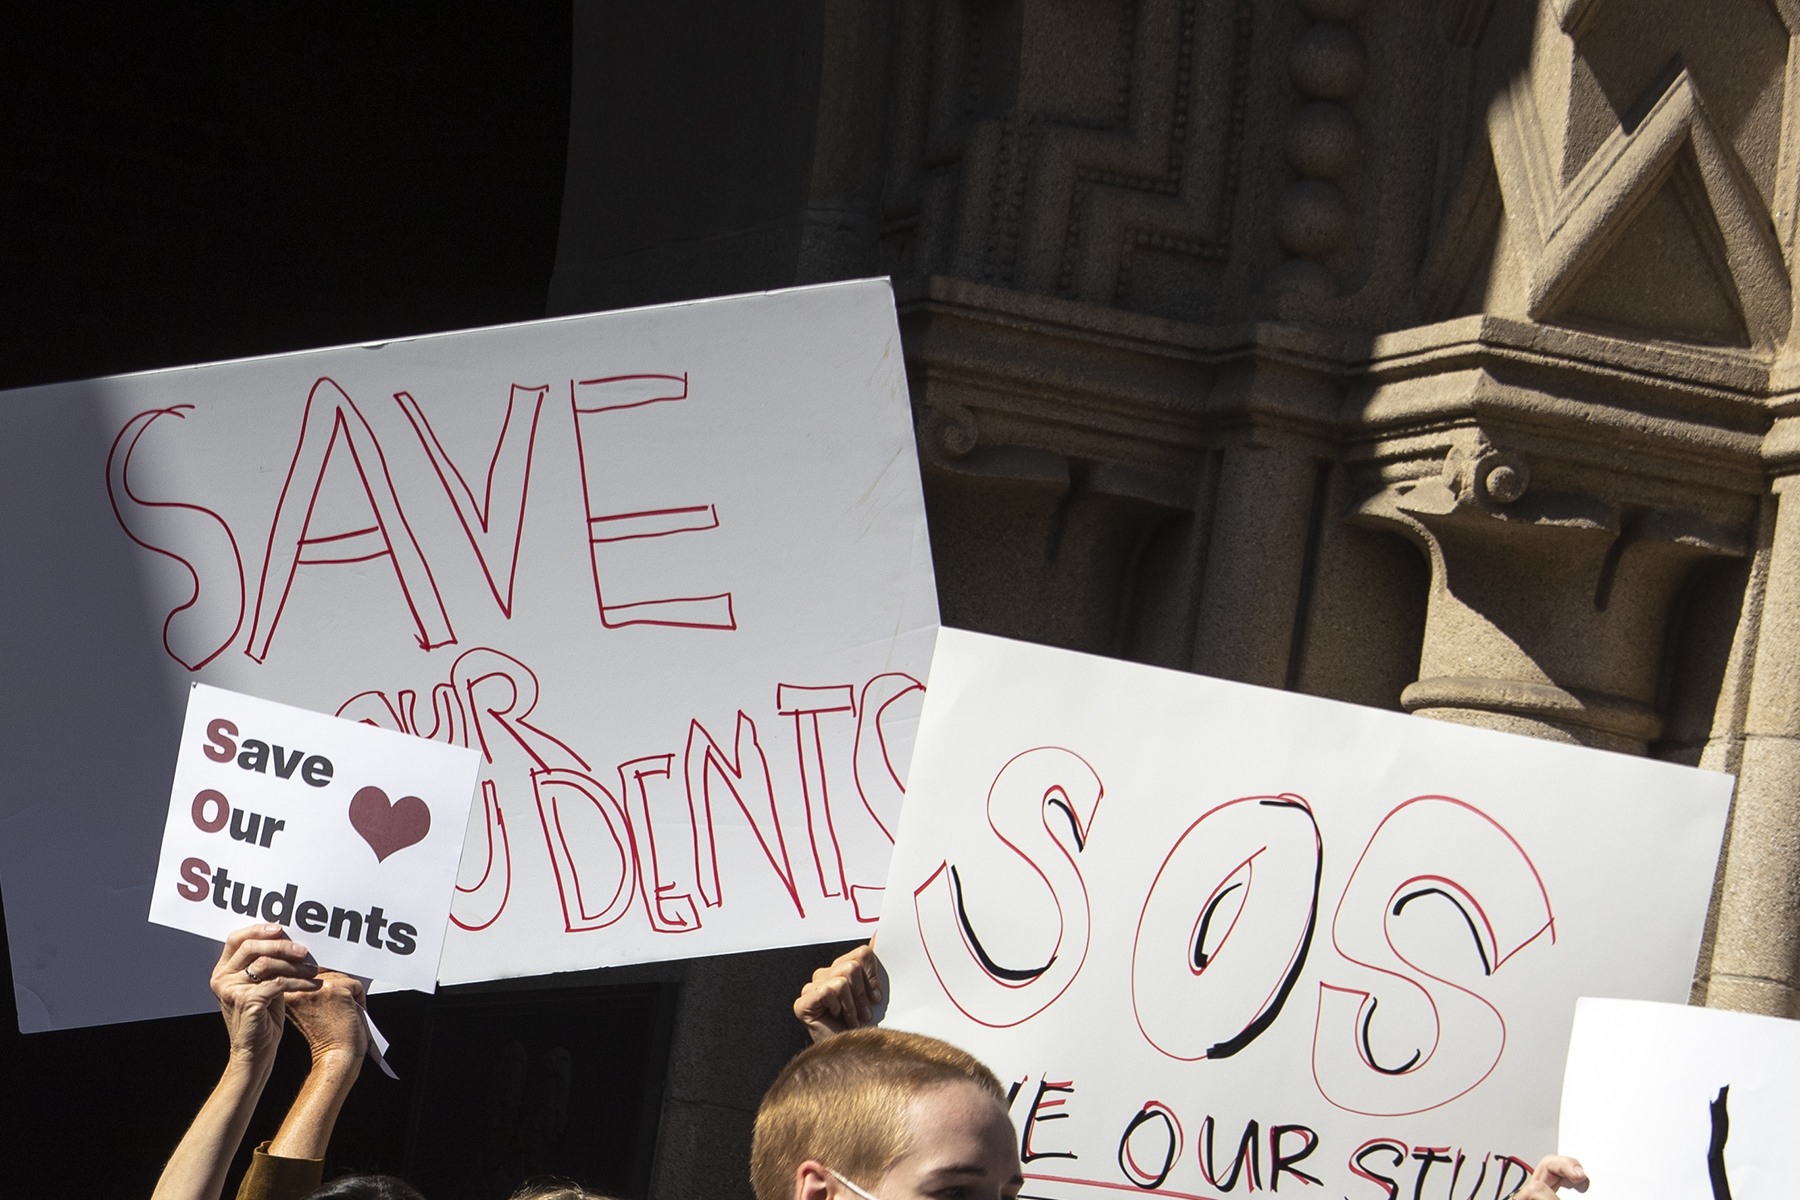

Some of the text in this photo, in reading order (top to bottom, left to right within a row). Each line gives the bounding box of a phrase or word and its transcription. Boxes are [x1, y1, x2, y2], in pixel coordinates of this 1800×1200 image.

[105, 372, 737, 671] SAVE
[202, 718, 334, 790] Save
[334, 647, 592, 776] UR
[190, 788, 285, 851] Our
[176, 857, 419, 957] Students
[914, 746, 1556, 1118] SOS
[1117, 1099, 1324, 1193] OUR
